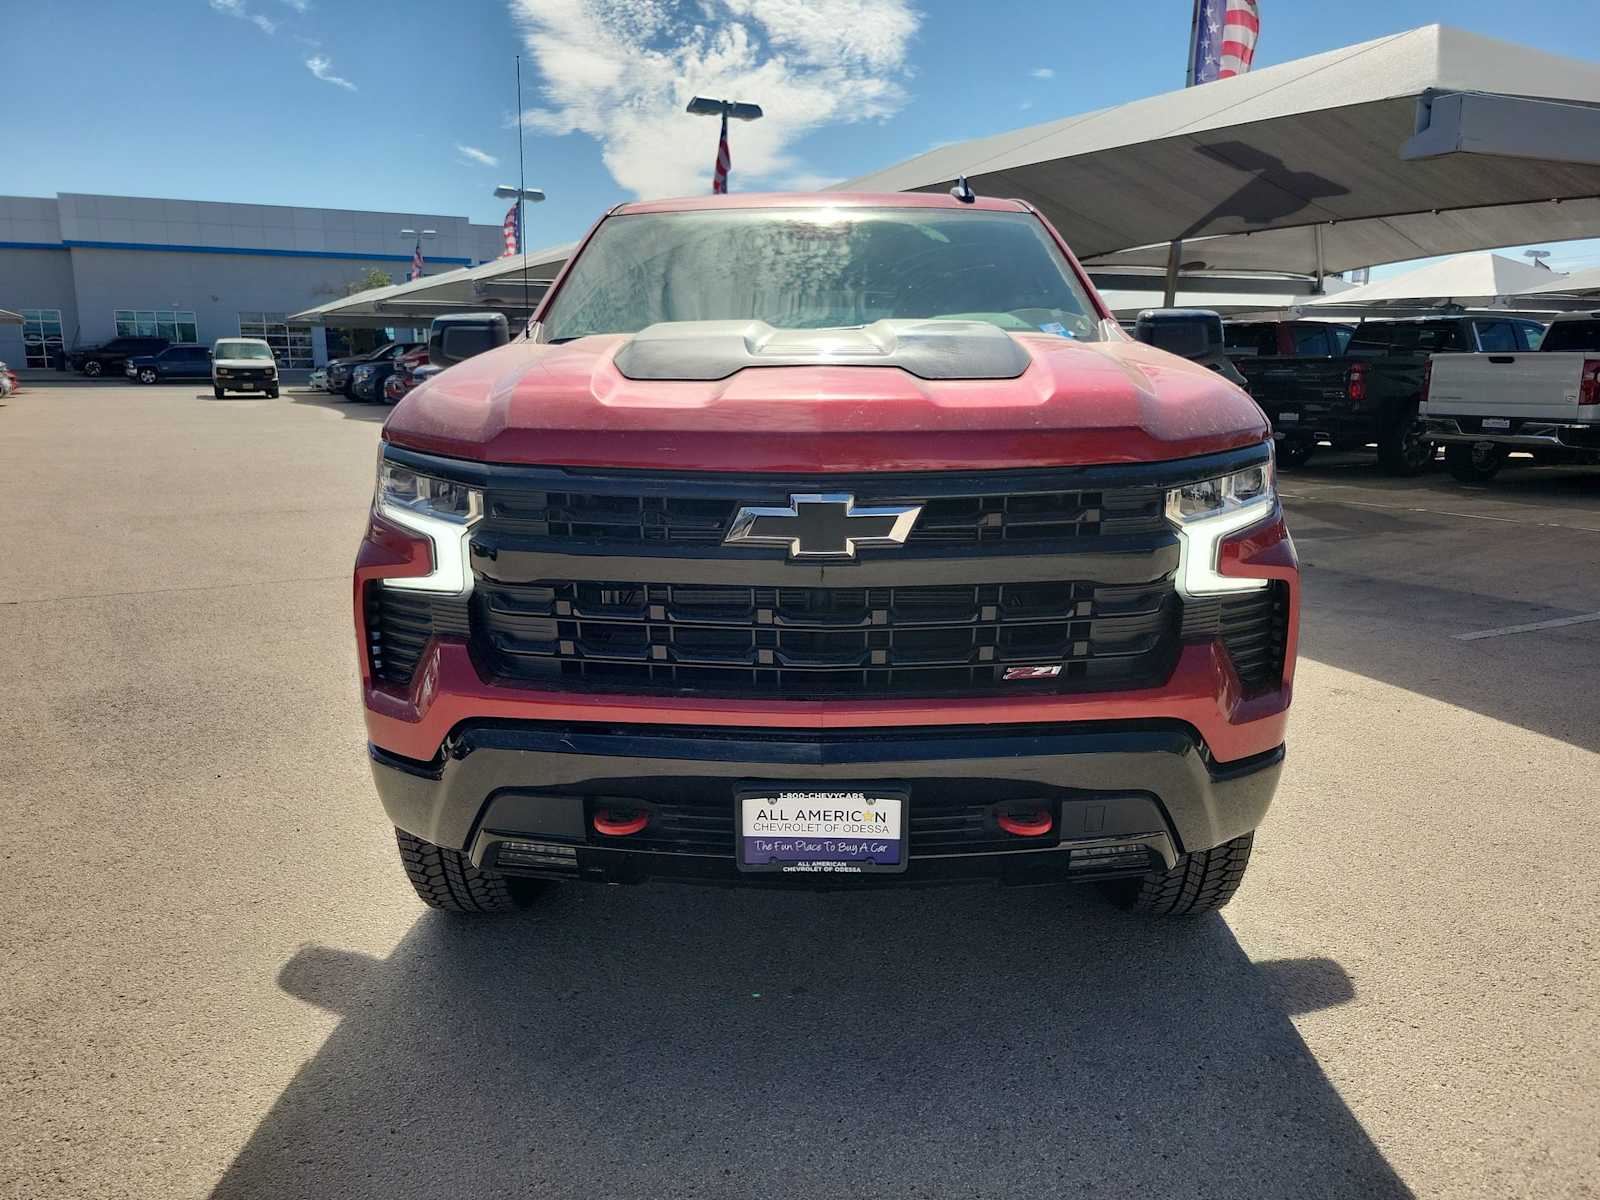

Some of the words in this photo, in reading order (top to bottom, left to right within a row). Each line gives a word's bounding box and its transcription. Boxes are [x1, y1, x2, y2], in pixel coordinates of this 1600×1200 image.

[1002, 666, 1062, 680] Z71
[779, 792, 865, 800] 1-800-CHEVYCARS
[756, 809, 789, 821] ALL
[795, 809, 887, 823] AMERICN
[753, 822, 821, 832] CHEVROLET
[824, 823, 840, 833] OF
[843, 824, 890, 834] ODESSA
[755, 840, 773, 851] The
[774, 841, 793, 851] Fun
[795, 840, 821, 852] Place
[823, 841, 835, 852] To
[838, 842, 858, 855] Buy
[859, 842, 868, 852] A
[870, 842, 888, 852] Car
